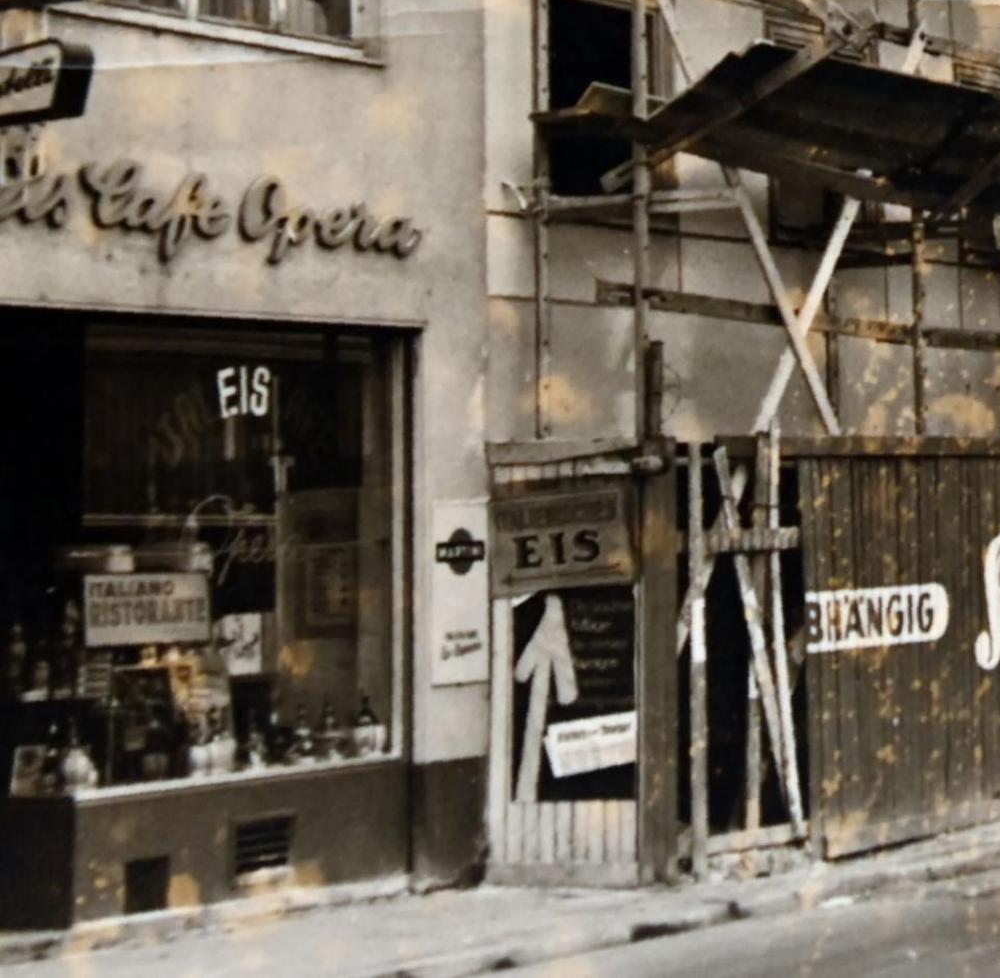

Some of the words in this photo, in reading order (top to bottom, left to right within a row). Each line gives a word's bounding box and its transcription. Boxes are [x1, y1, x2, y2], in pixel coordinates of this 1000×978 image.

[237, 176, 422, 267] Opera
[217, 366, 270, 418] EIS
[512, 530, 600, 569] EIS
